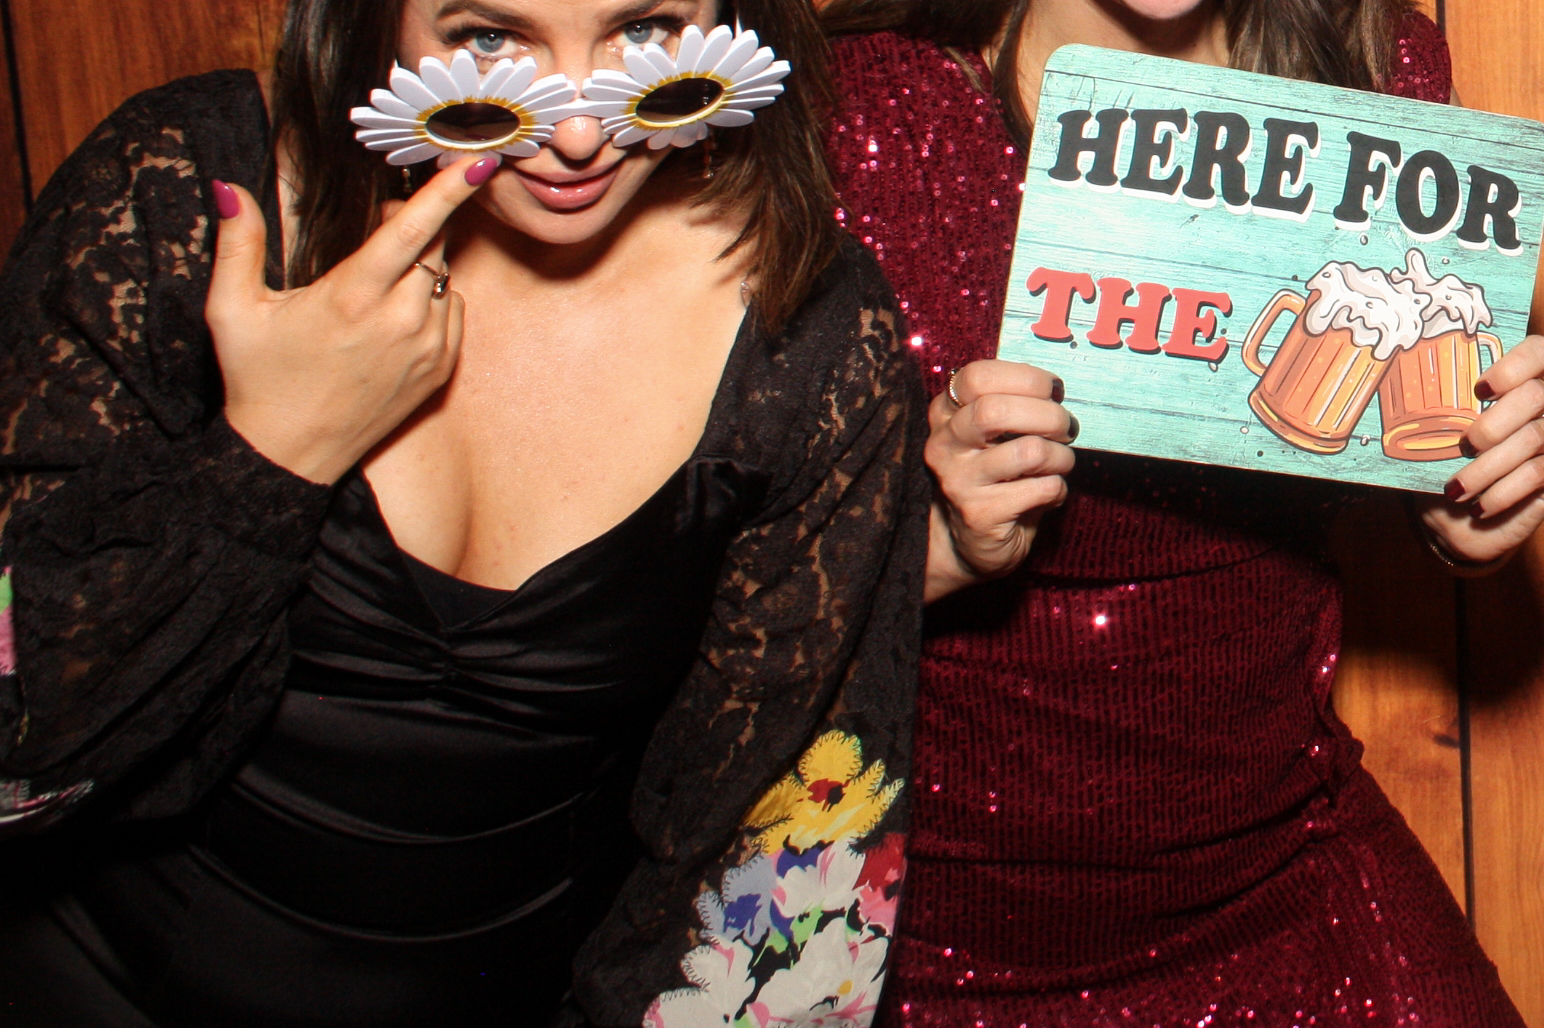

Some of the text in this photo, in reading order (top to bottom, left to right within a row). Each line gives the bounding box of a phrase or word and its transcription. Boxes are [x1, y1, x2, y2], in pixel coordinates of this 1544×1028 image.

[1047, 108, 1523, 255] HERE FOR
[1026, 266, 1232, 362] THE
